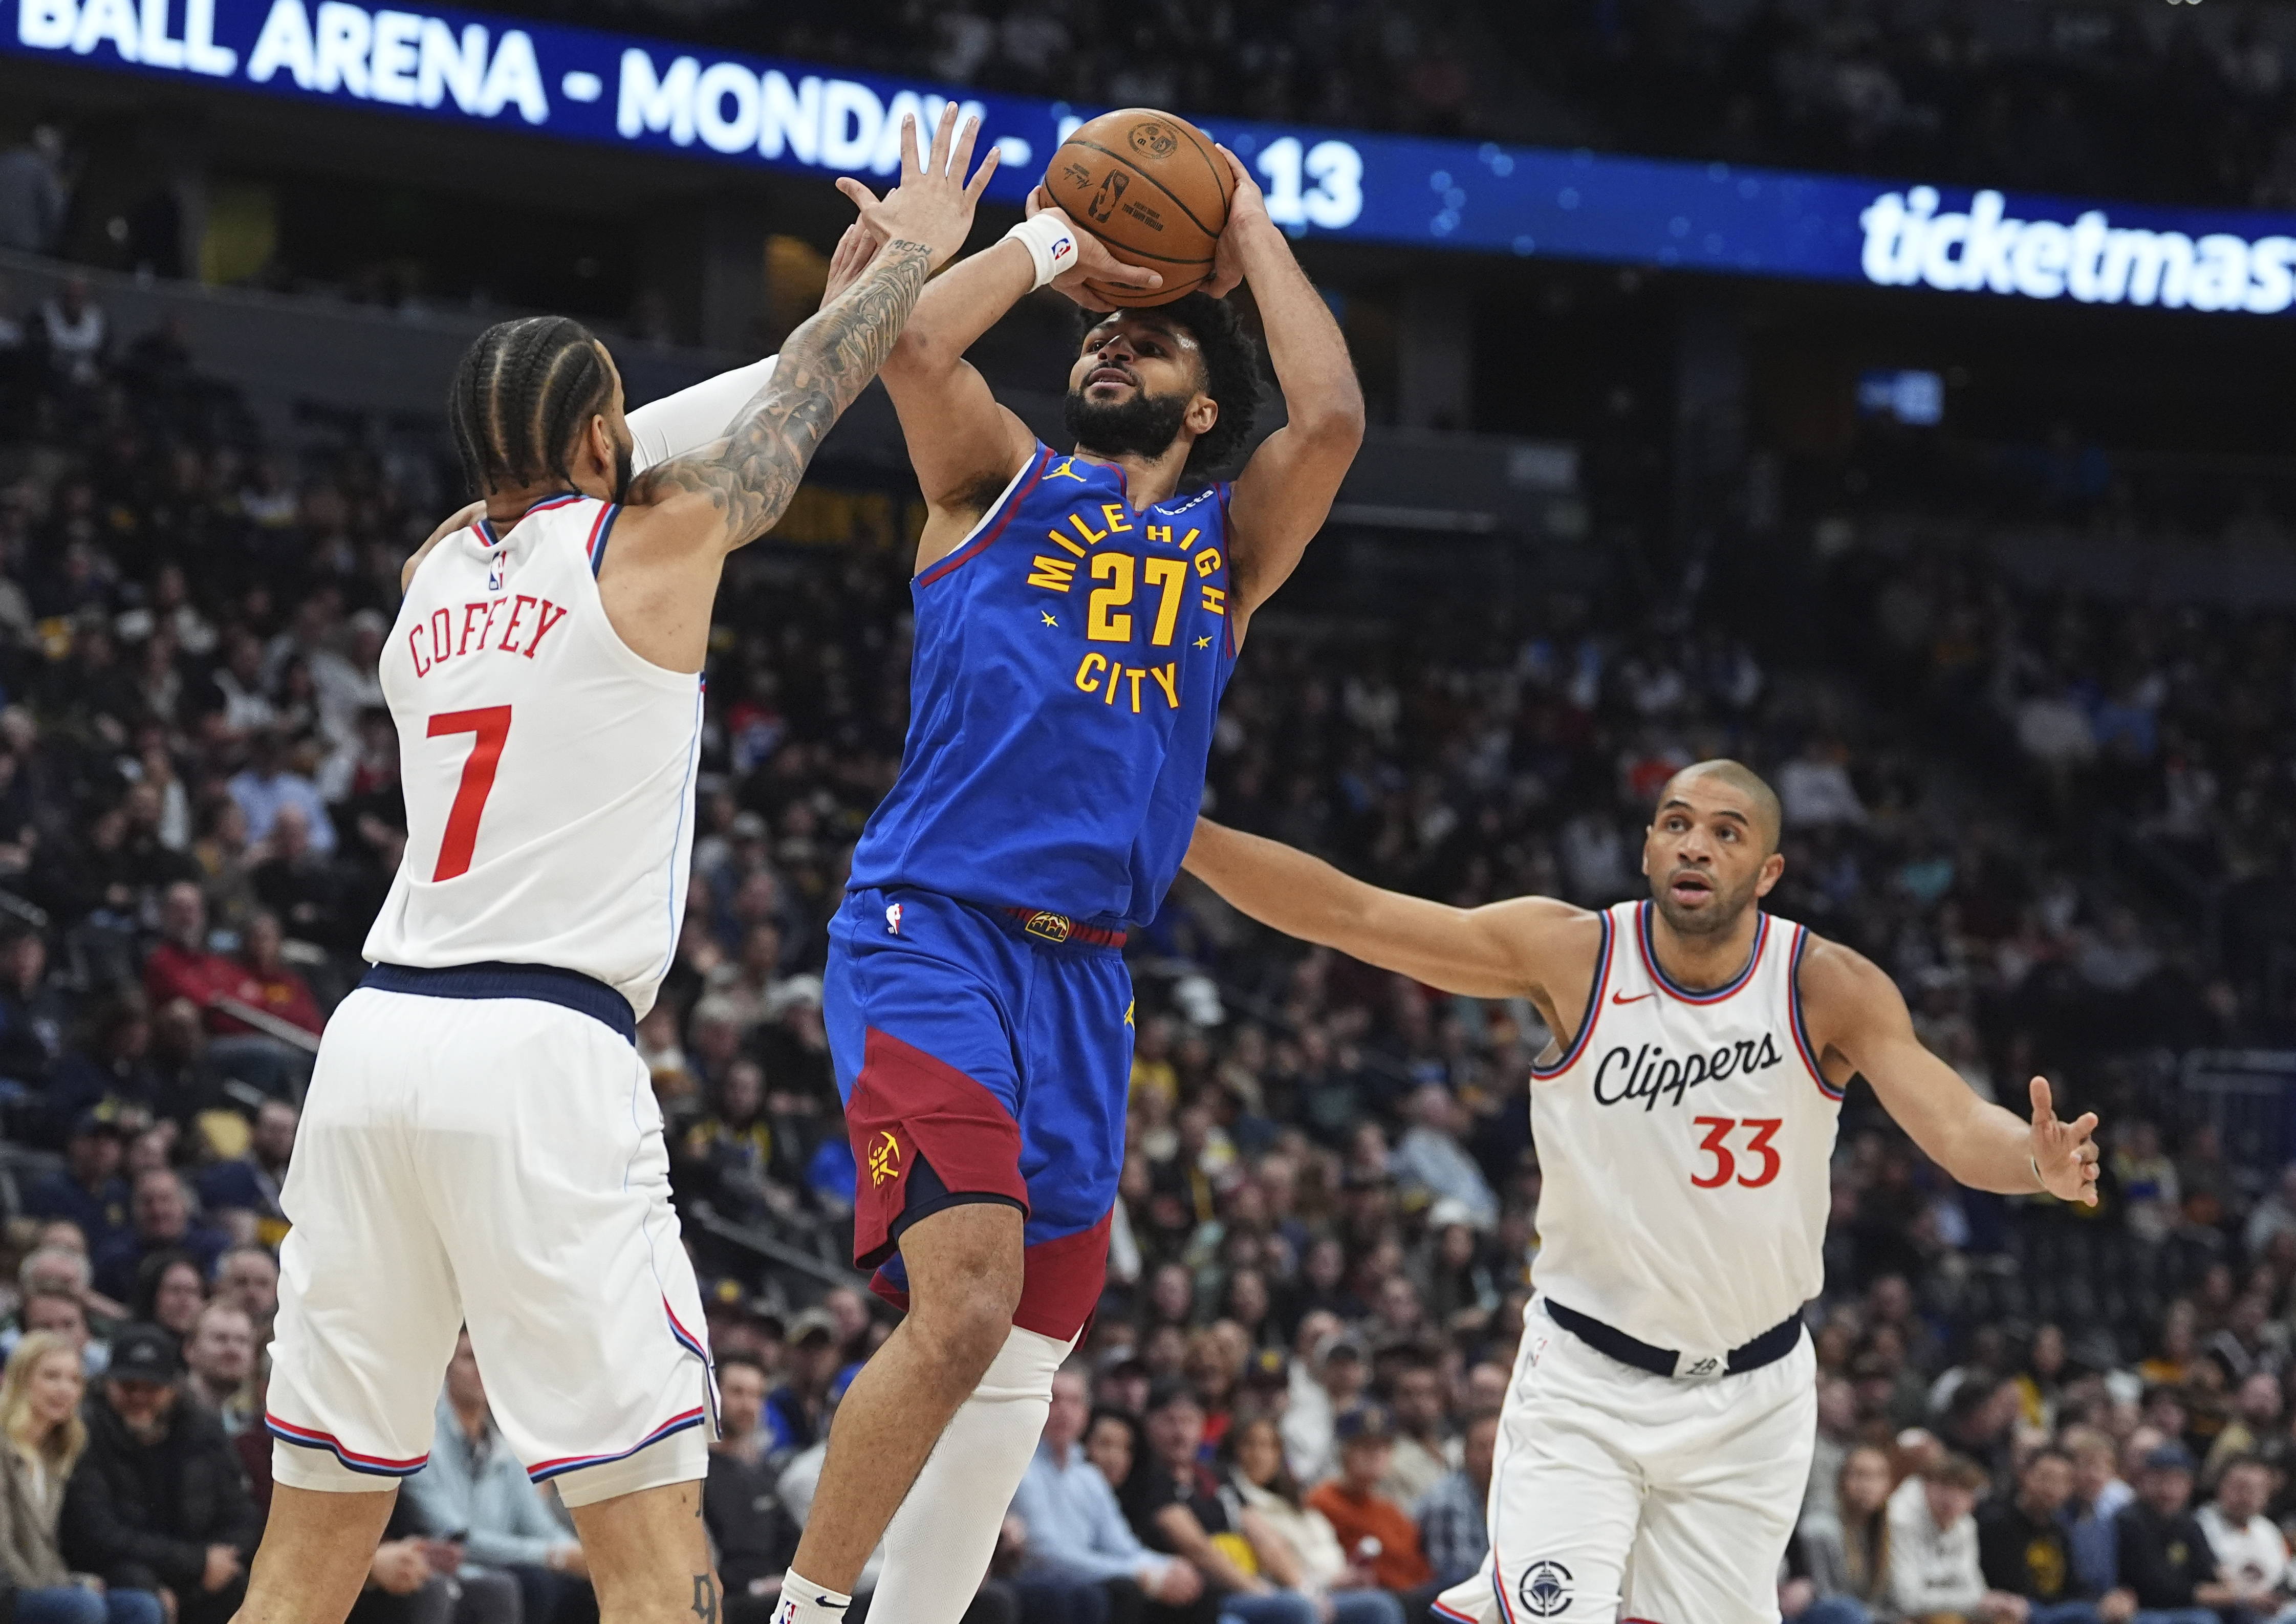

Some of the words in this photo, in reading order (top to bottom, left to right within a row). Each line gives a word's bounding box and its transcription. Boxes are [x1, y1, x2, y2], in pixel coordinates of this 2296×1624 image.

[17, 0, 239, 78] BALL
[247, 0, 549, 124] ARENA
[1255, 136, 1364, 229] 13
[1859, 185, 2296, 314] ticketmas
[1026, 503, 1133, 593] MILE
[1146, 525, 1226, 616] HIGH
[1087, 552, 1188, 646] 27
[409, 594, 567, 678] COFFEY
[1075, 652, 1179, 714] CITY
[426, 704, 512, 883] 7
[1593, 1032, 1783, 1112] Clippers
[1691, 1115, 1783, 1189] 33
